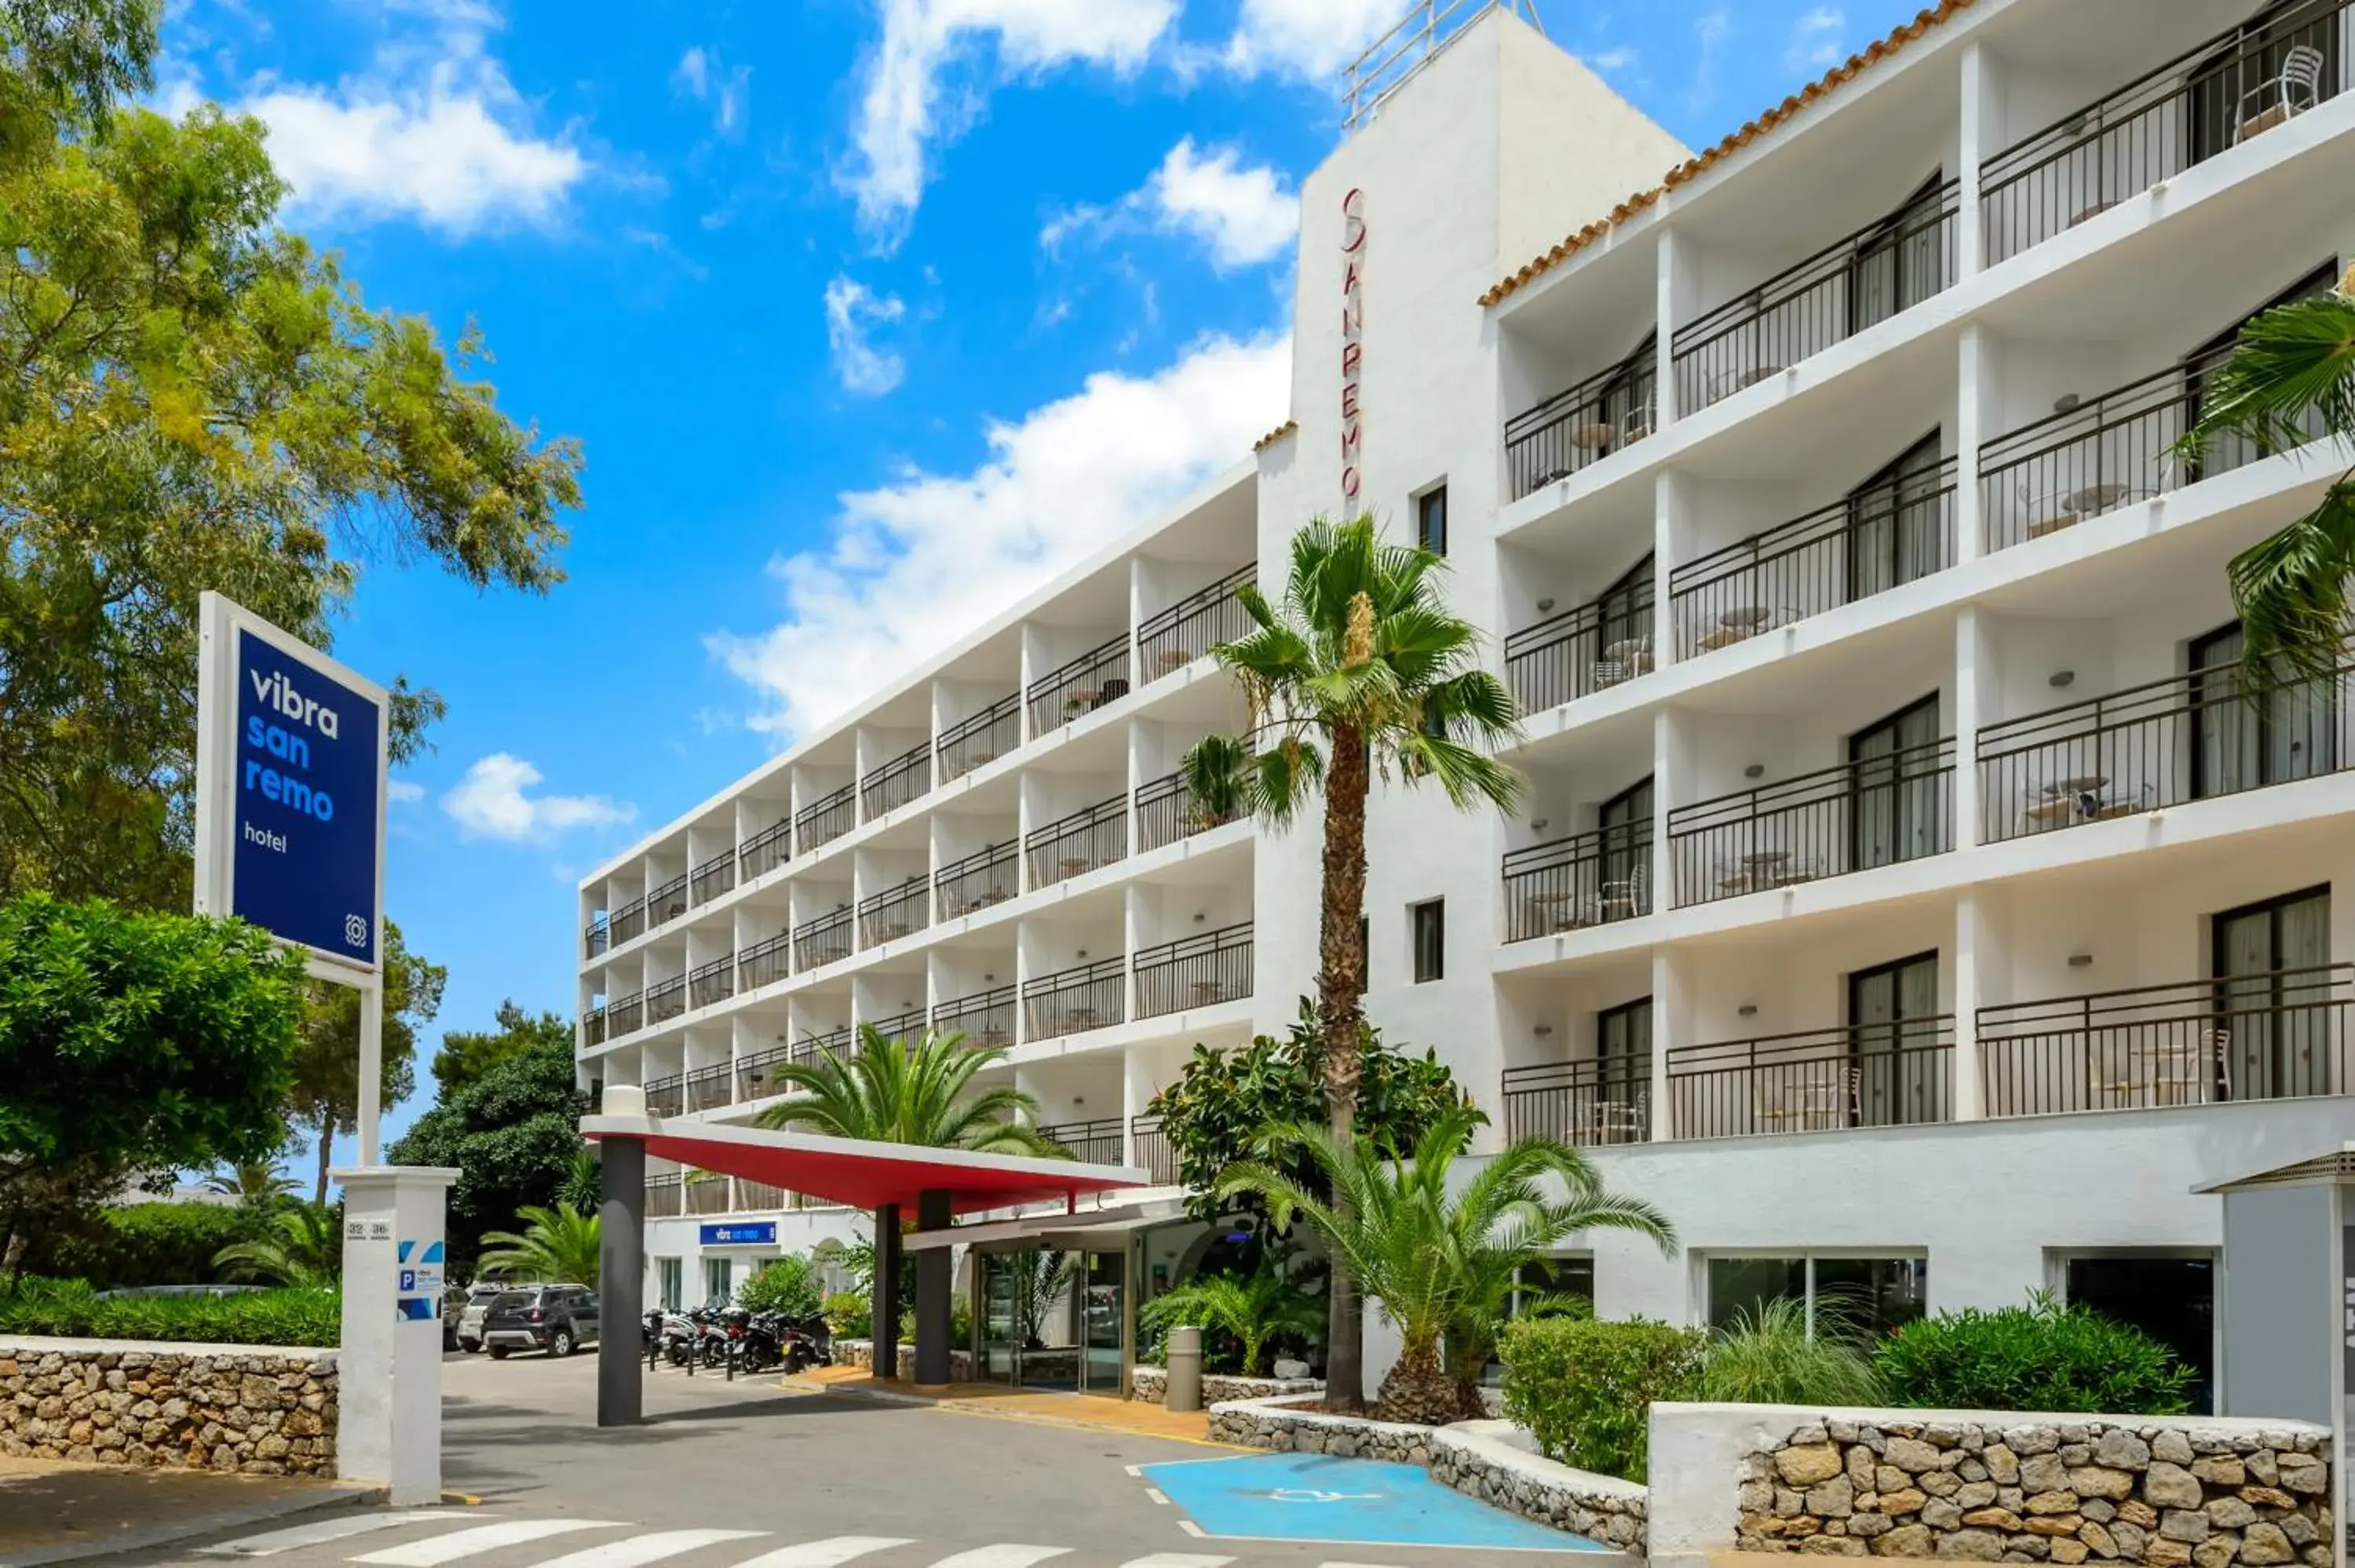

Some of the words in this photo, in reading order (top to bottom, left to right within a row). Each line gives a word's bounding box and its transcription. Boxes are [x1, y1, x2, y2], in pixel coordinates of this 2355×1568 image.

[250, 669, 338, 739] vibra
[247, 715, 309, 768] san
[246, 760, 333, 821] remo
[245, 822, 287, 853] hotel
[403, 1274, 412, 1288] P
